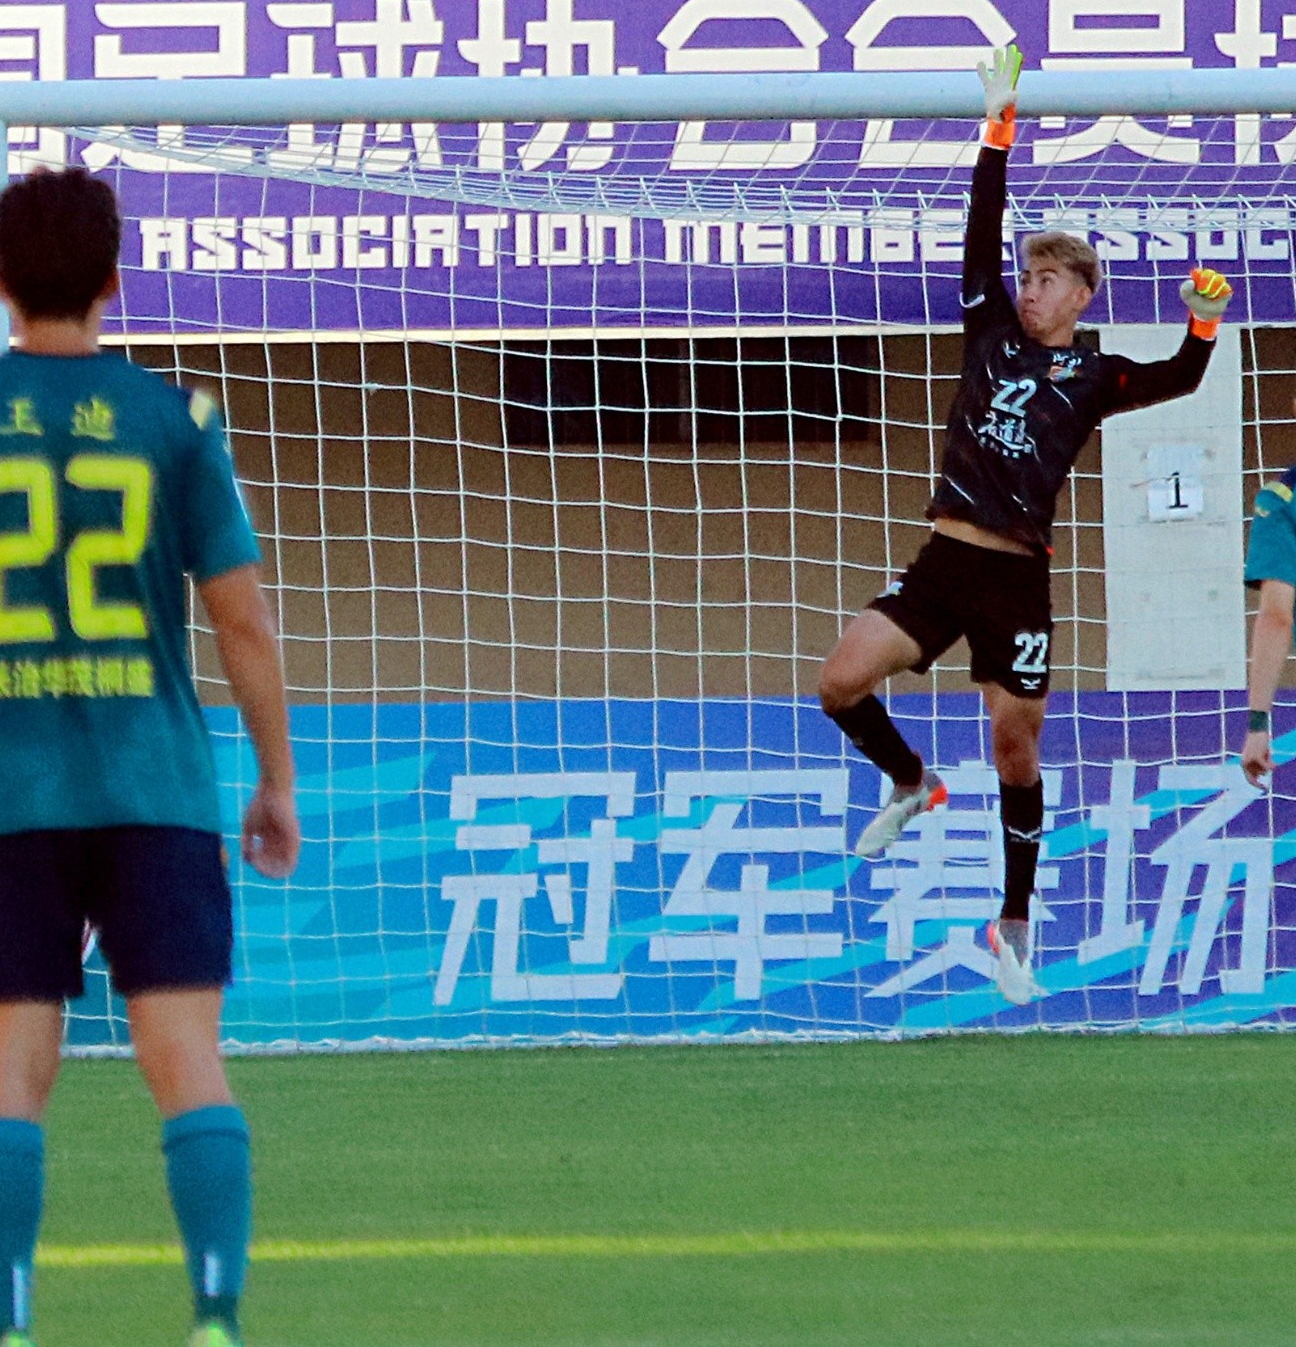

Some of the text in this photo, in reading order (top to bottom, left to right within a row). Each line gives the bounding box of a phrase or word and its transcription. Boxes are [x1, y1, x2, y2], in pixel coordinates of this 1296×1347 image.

[139, 213, 632, 271] ASSOCIATION
[664, 209, 1015, 265] MEMBE
[1165, 471, 1189, 510] 1
[1012, 632, 1049, 673] 22
[434, 758, 1272, 1007] 冠军赛场
